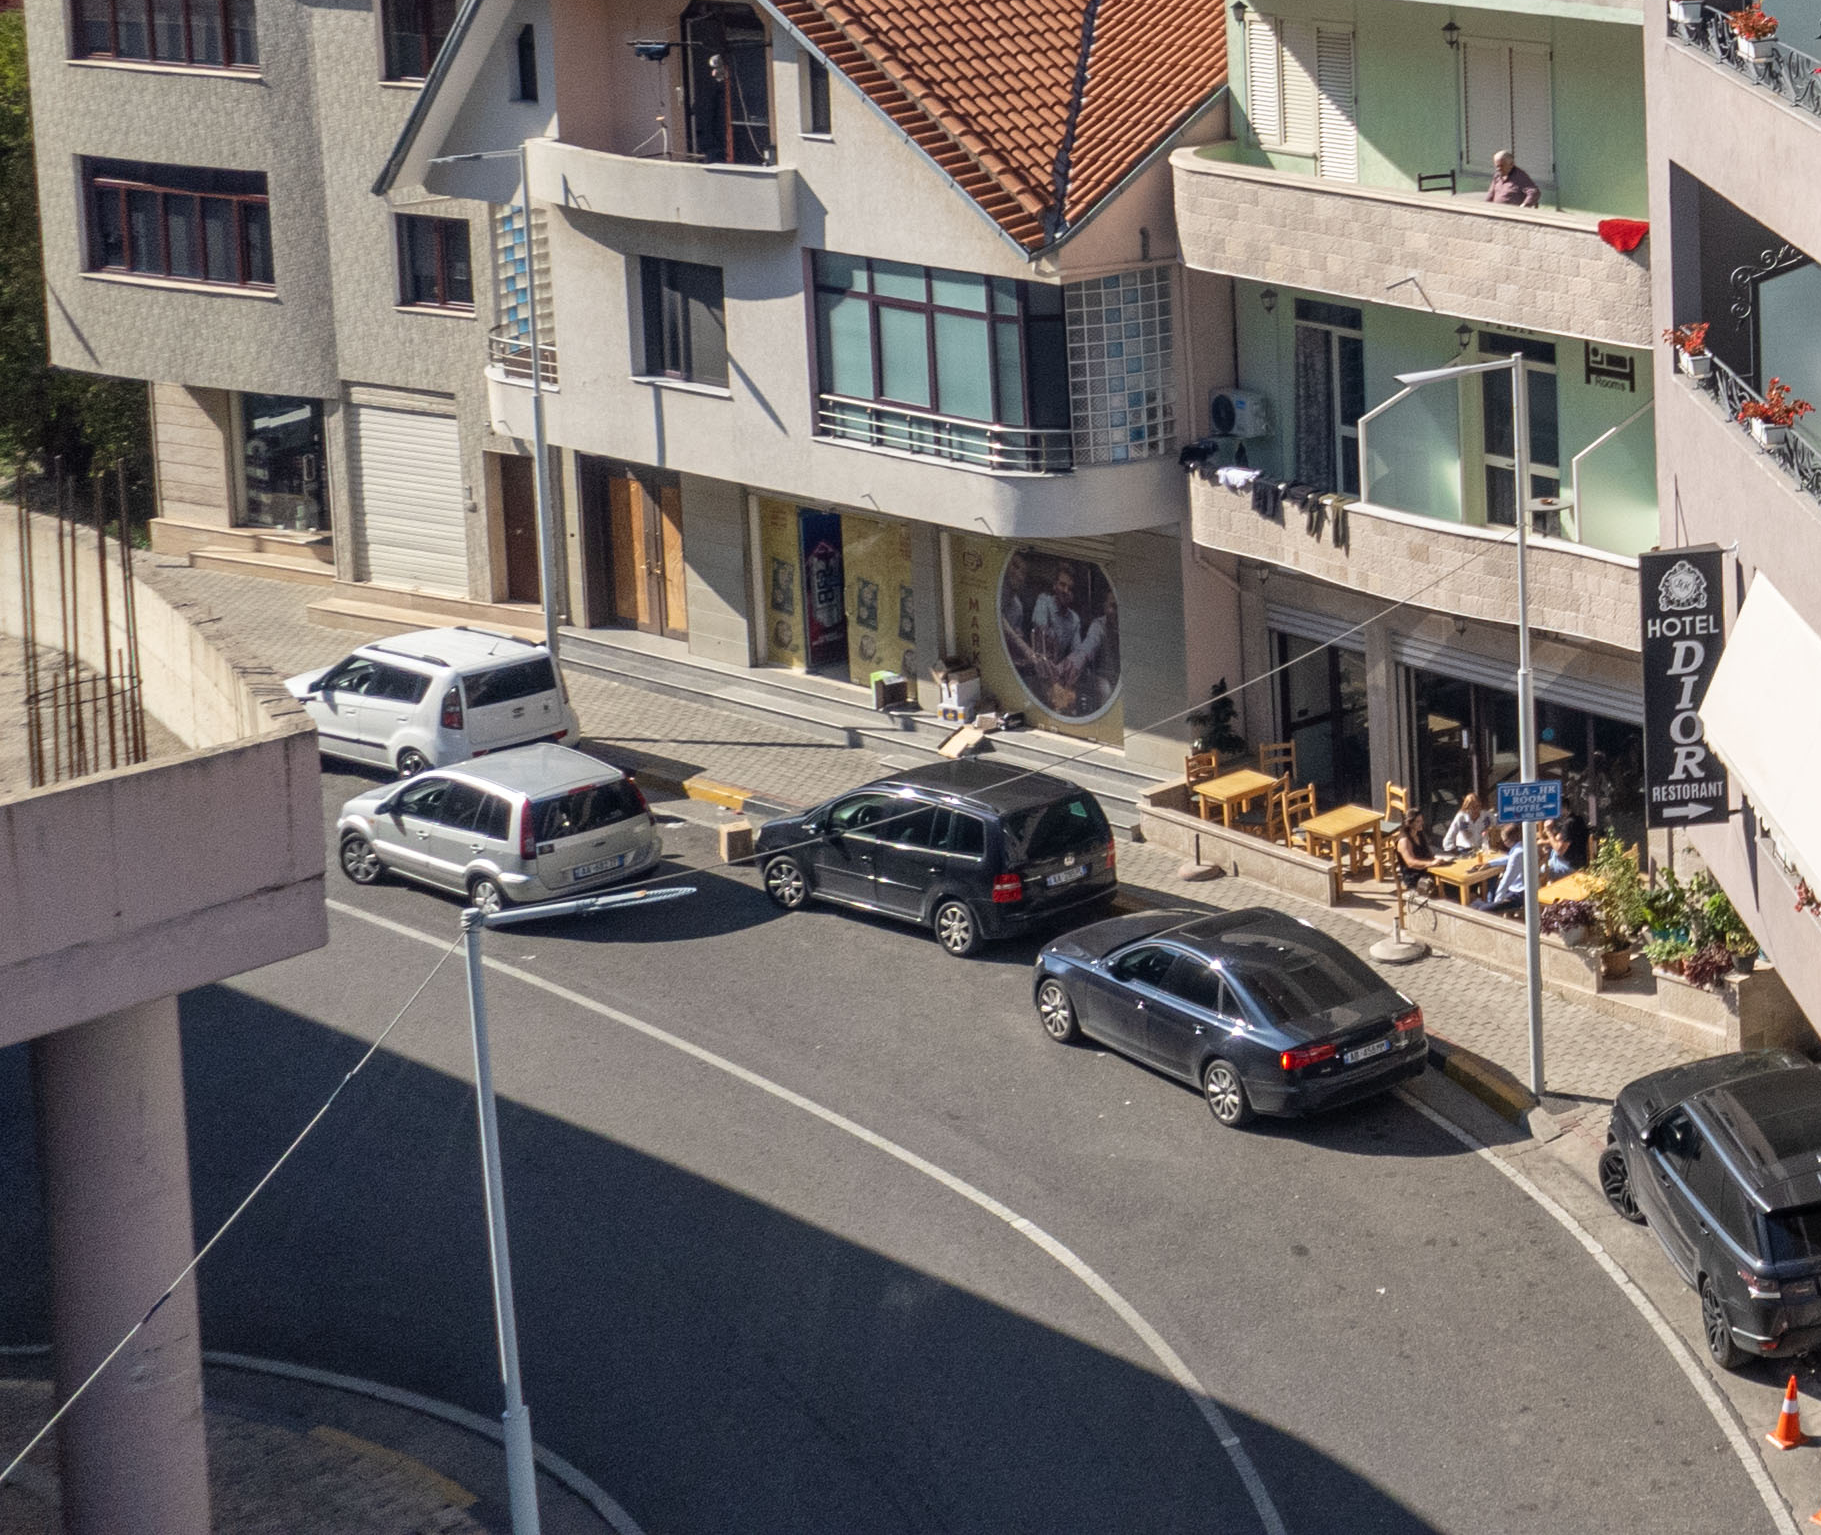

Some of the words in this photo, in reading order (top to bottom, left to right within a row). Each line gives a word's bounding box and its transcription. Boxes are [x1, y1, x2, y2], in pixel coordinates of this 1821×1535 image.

[1595, 376, 1626, 392] Rooms
[1648, 615, 1720, 638] HOTEL
[1666, 640, 1706, 781] DIOR
[1504, 787, 1529, 797] VILA
[1512, 795, 1547, 805] ROOM
[1652, 781, 1723, 802] RESTORANT
